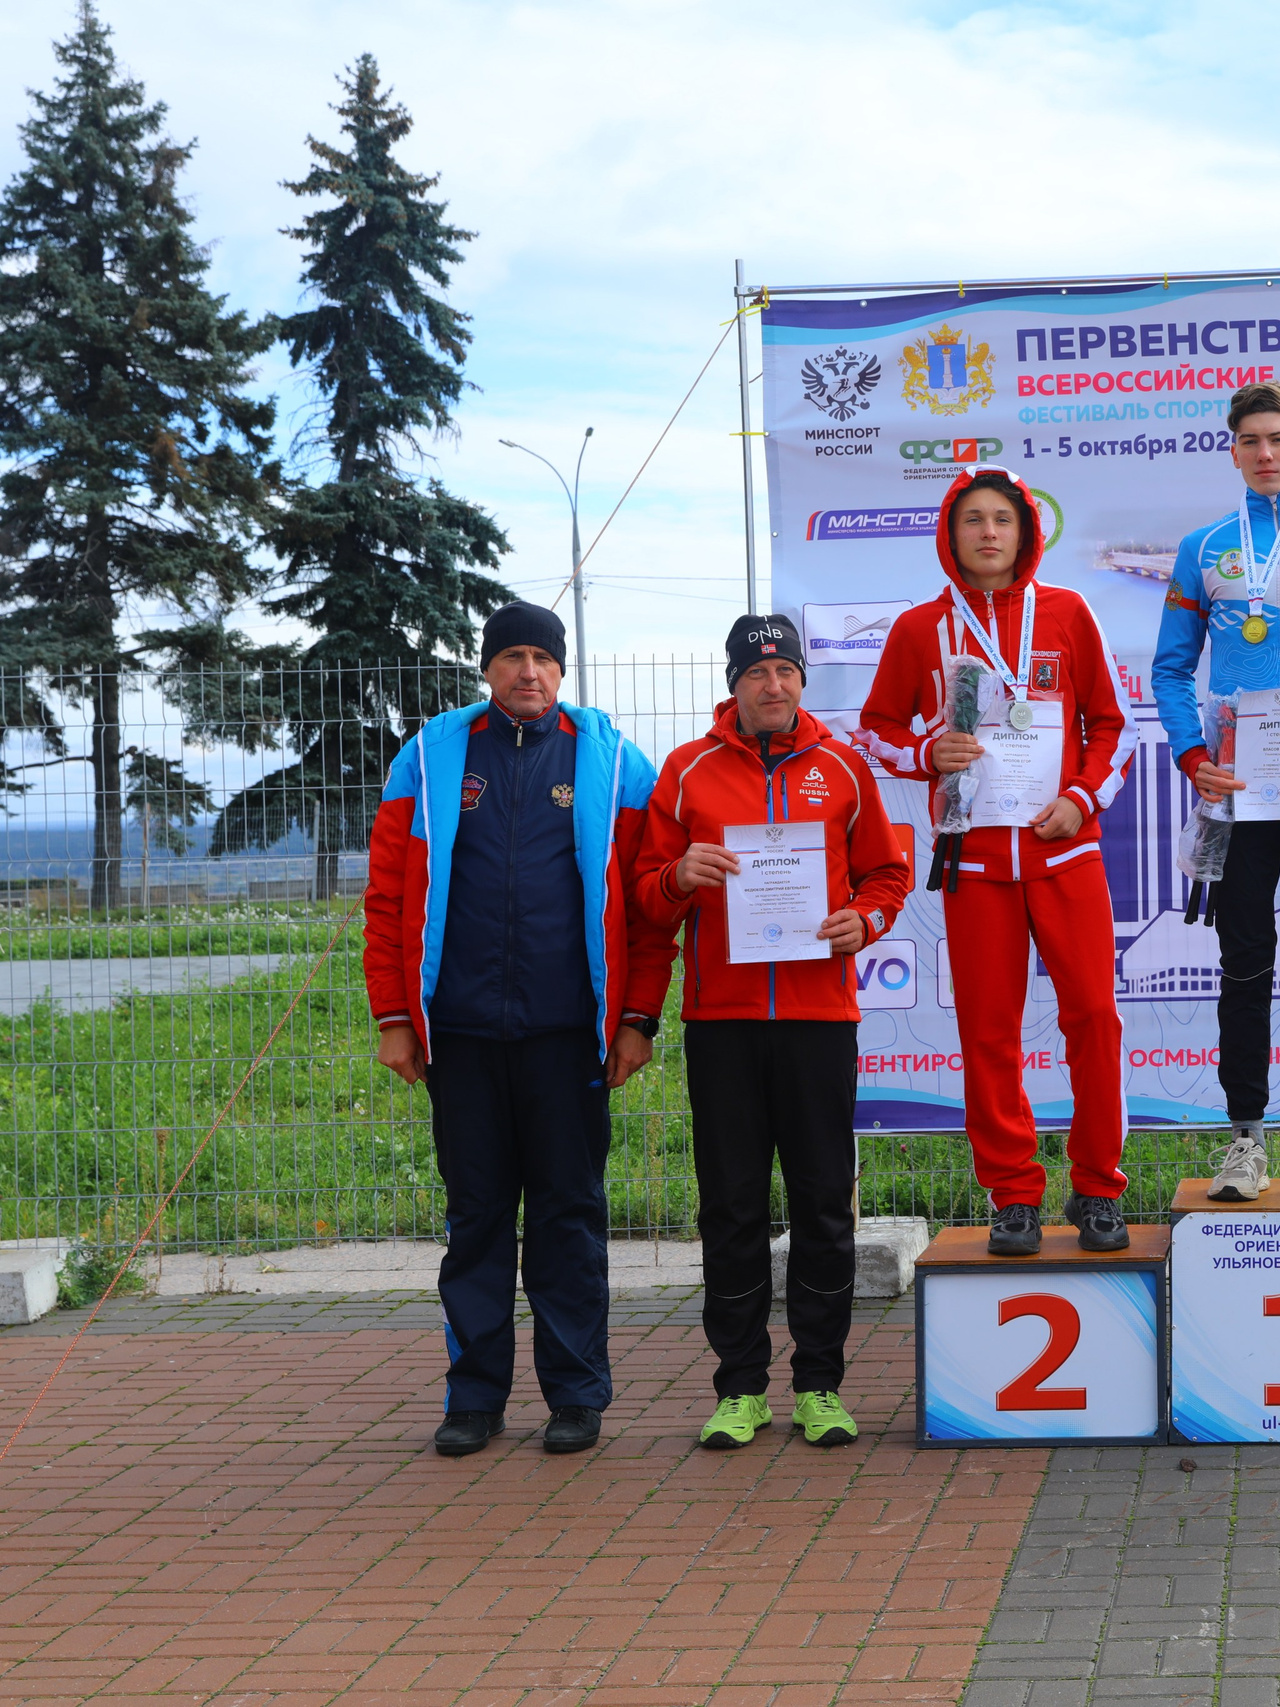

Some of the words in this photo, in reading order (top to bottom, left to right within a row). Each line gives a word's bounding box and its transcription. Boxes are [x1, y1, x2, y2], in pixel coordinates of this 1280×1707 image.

[1017, 363, 1274, 397] ВСЕРОССИЙСКИЕ
[1018, 402, 1149, 425] ФЕСТИВАЛЬ
[805, 427, 881, 440] МИНСПОРТ
[815, 444, 873, 456] РОССИИ
[1023, 438, 1035, 459] 1
[1058, 437, 1072, 457] 5
[1078, 434, 1177, 460] октября
[1183, 431, 1237, 452] 202
[828, 512, 940, 529] МИНСПОР
[992, 732, 1038, 741] ДИПЛОМ
[802, 781, 828, 789] odlo
[799, 789, 830, 797] RUSSIA
[752, 857, 800, 869] ДИПЛОМ
[996, 1292, 1087, 1411] 2
